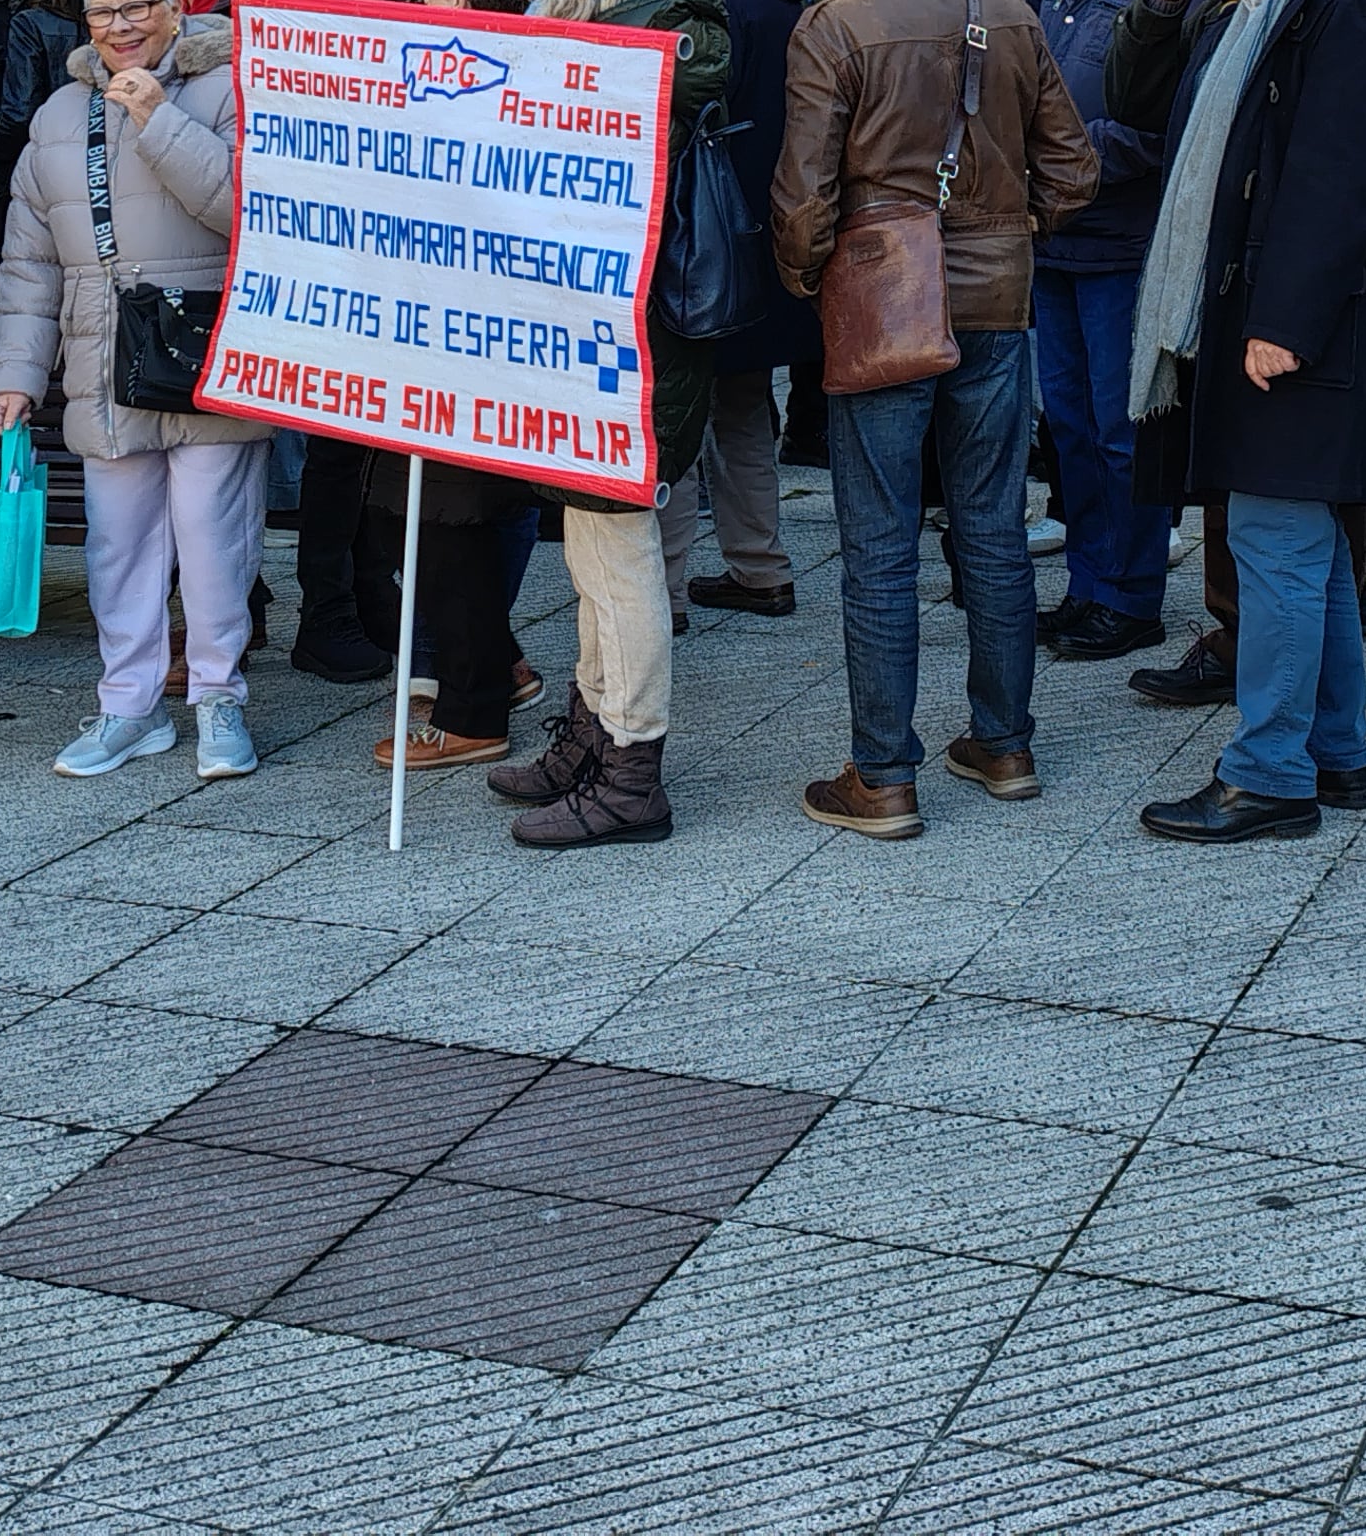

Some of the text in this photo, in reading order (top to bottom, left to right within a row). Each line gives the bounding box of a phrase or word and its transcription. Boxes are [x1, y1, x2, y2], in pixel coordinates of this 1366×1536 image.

[250, 16, 387, 64] MOVIMIENTO
[250, 60, 408, 110] PENSIONISTAS
[417, 50, 481, 89] A.P.G.
[563, 61, 602, 93] DE
[498, 88, 643, 142] ASTURIAS
[251, 112, 644, 211] SANIDAD PUBLICA UNIVERSAL
[248, 190, 636, 299] ATENCION PRIMARIA PRESENCIAL
[238, 270, 571, 372] SIN LISTAS DE ESPERA
[217, 350, 387, 423] PROMESAS
[400, 384, 457, 437] SIN
[472, 397, 633, 468] CUMPLIR
